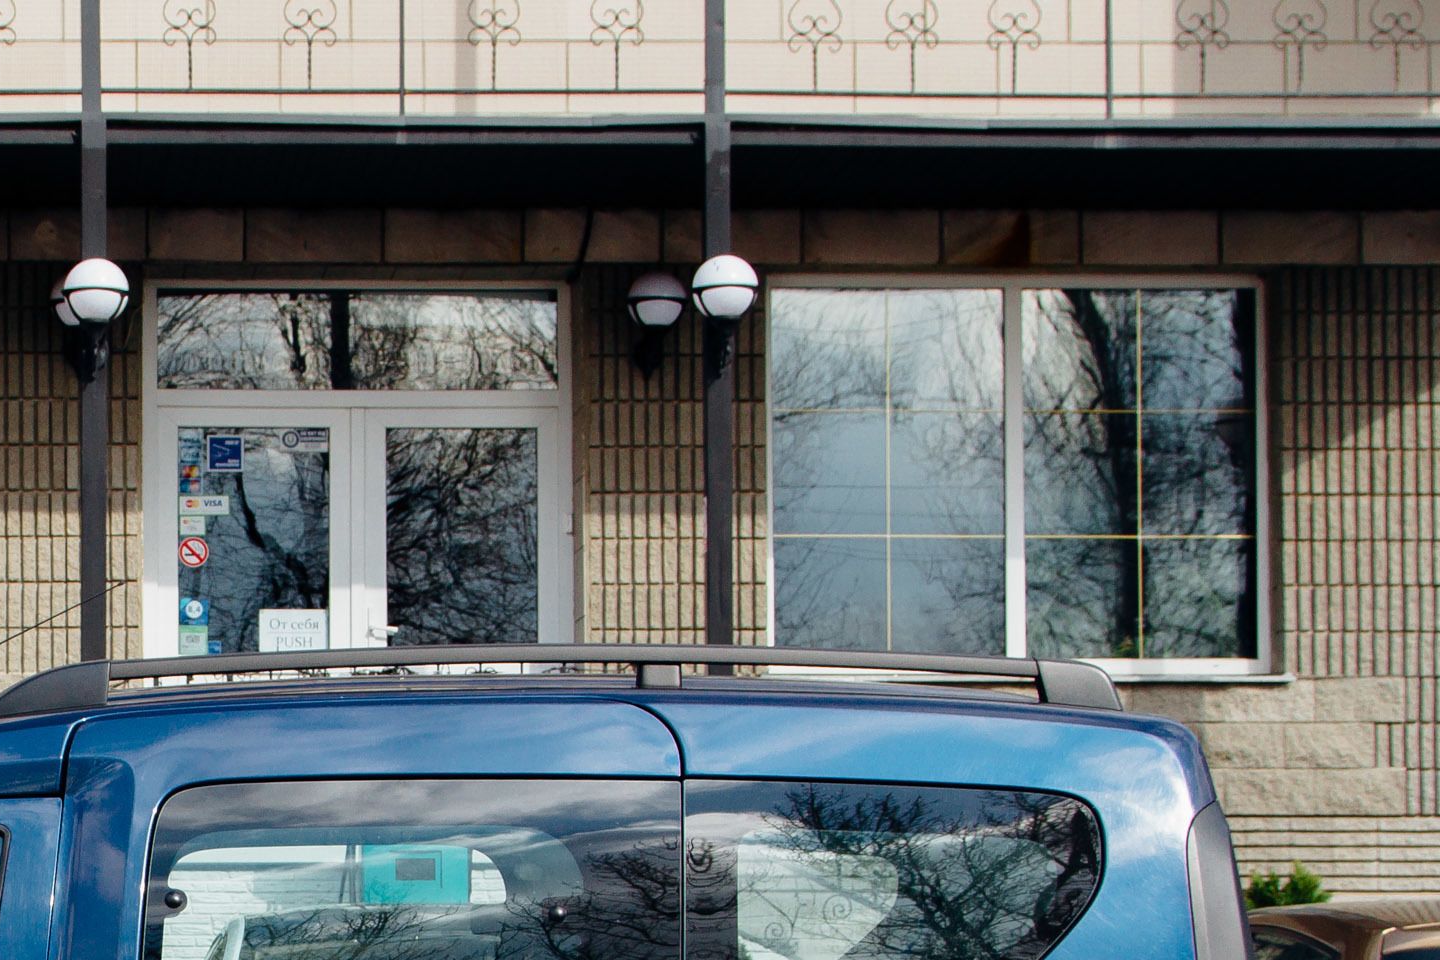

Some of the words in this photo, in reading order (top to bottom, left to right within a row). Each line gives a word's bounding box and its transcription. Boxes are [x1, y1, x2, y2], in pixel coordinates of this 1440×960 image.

[203, 499, 223, 508] VISA
[269, 618, 287, 630] От
[290, 618, 320, 631] себя
[276, 636, 313, 648] PUSH
